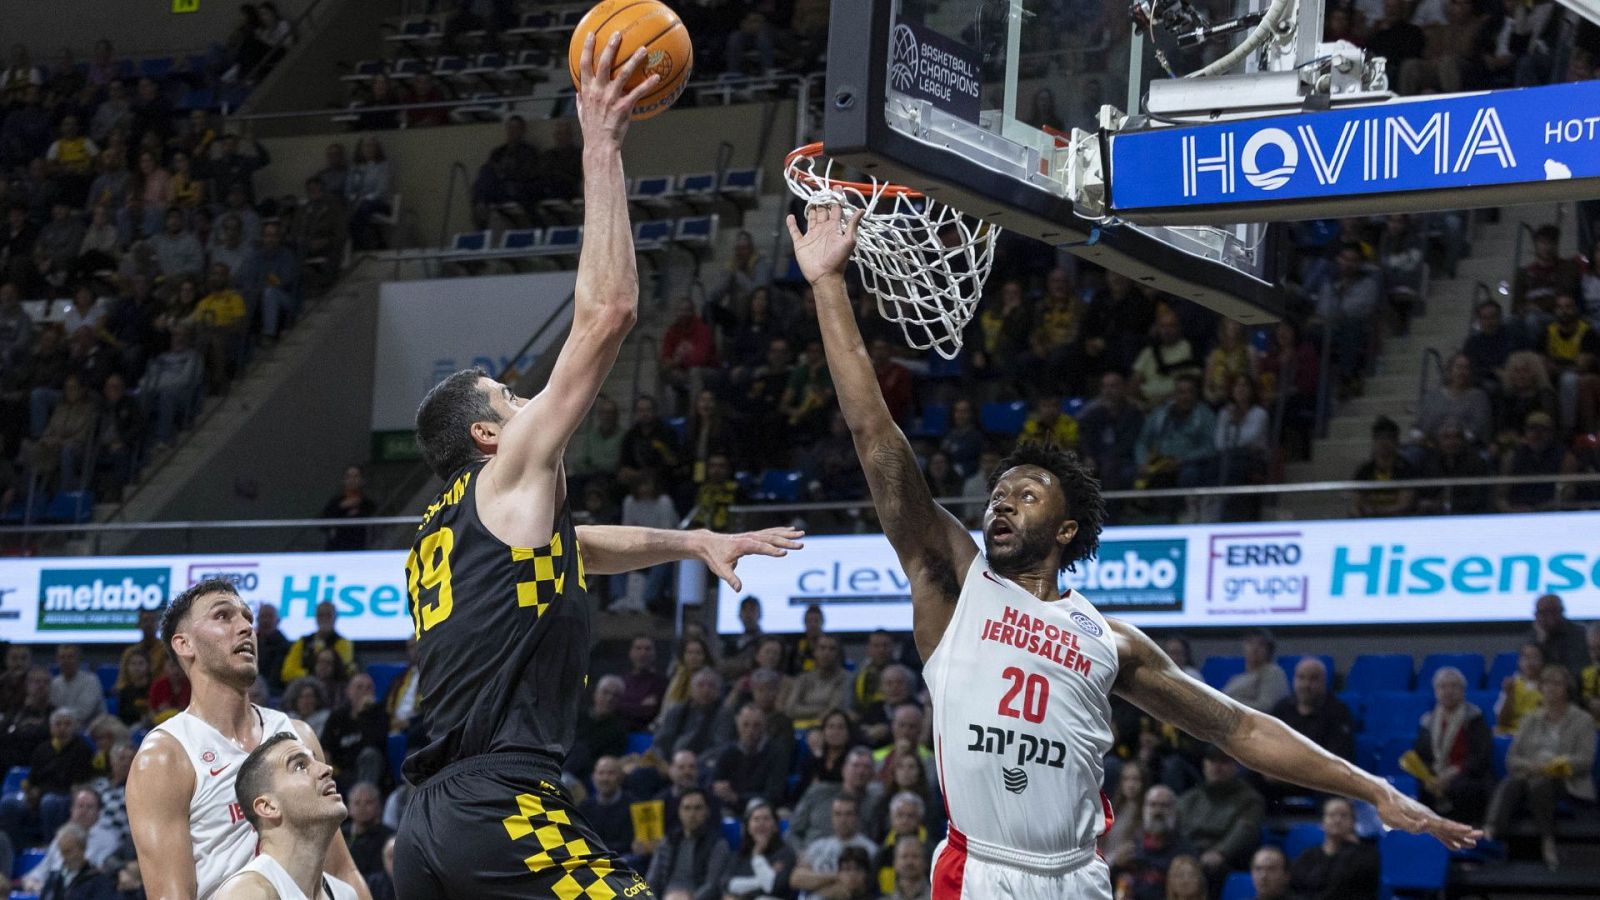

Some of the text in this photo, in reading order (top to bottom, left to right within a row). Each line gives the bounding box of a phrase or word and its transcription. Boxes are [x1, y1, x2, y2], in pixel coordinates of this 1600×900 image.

[920, 59, 979, 98] CHAMPIONS
[921, 43, 973, 77] BASKETBALL
[919, 76, 952, 102] LEAGUE
[1181, 106, 1600, 198] HOVIMA HOT
[405, 527, 454, 641] 19
[1058, 551, 1178, 590] etabo
[1224, 575, 1300, 601] grupo
[1330, 544, 1600, 597] Hisens
[44, 576, 163, 611] metabo
[981, 618, 1092, 678] JERUSALEM
[1002, 606, 1081, 651] HAPOEL
[997, 666, 1050, 724] 20
[968, 723, 1067, 769] בנק יהב
